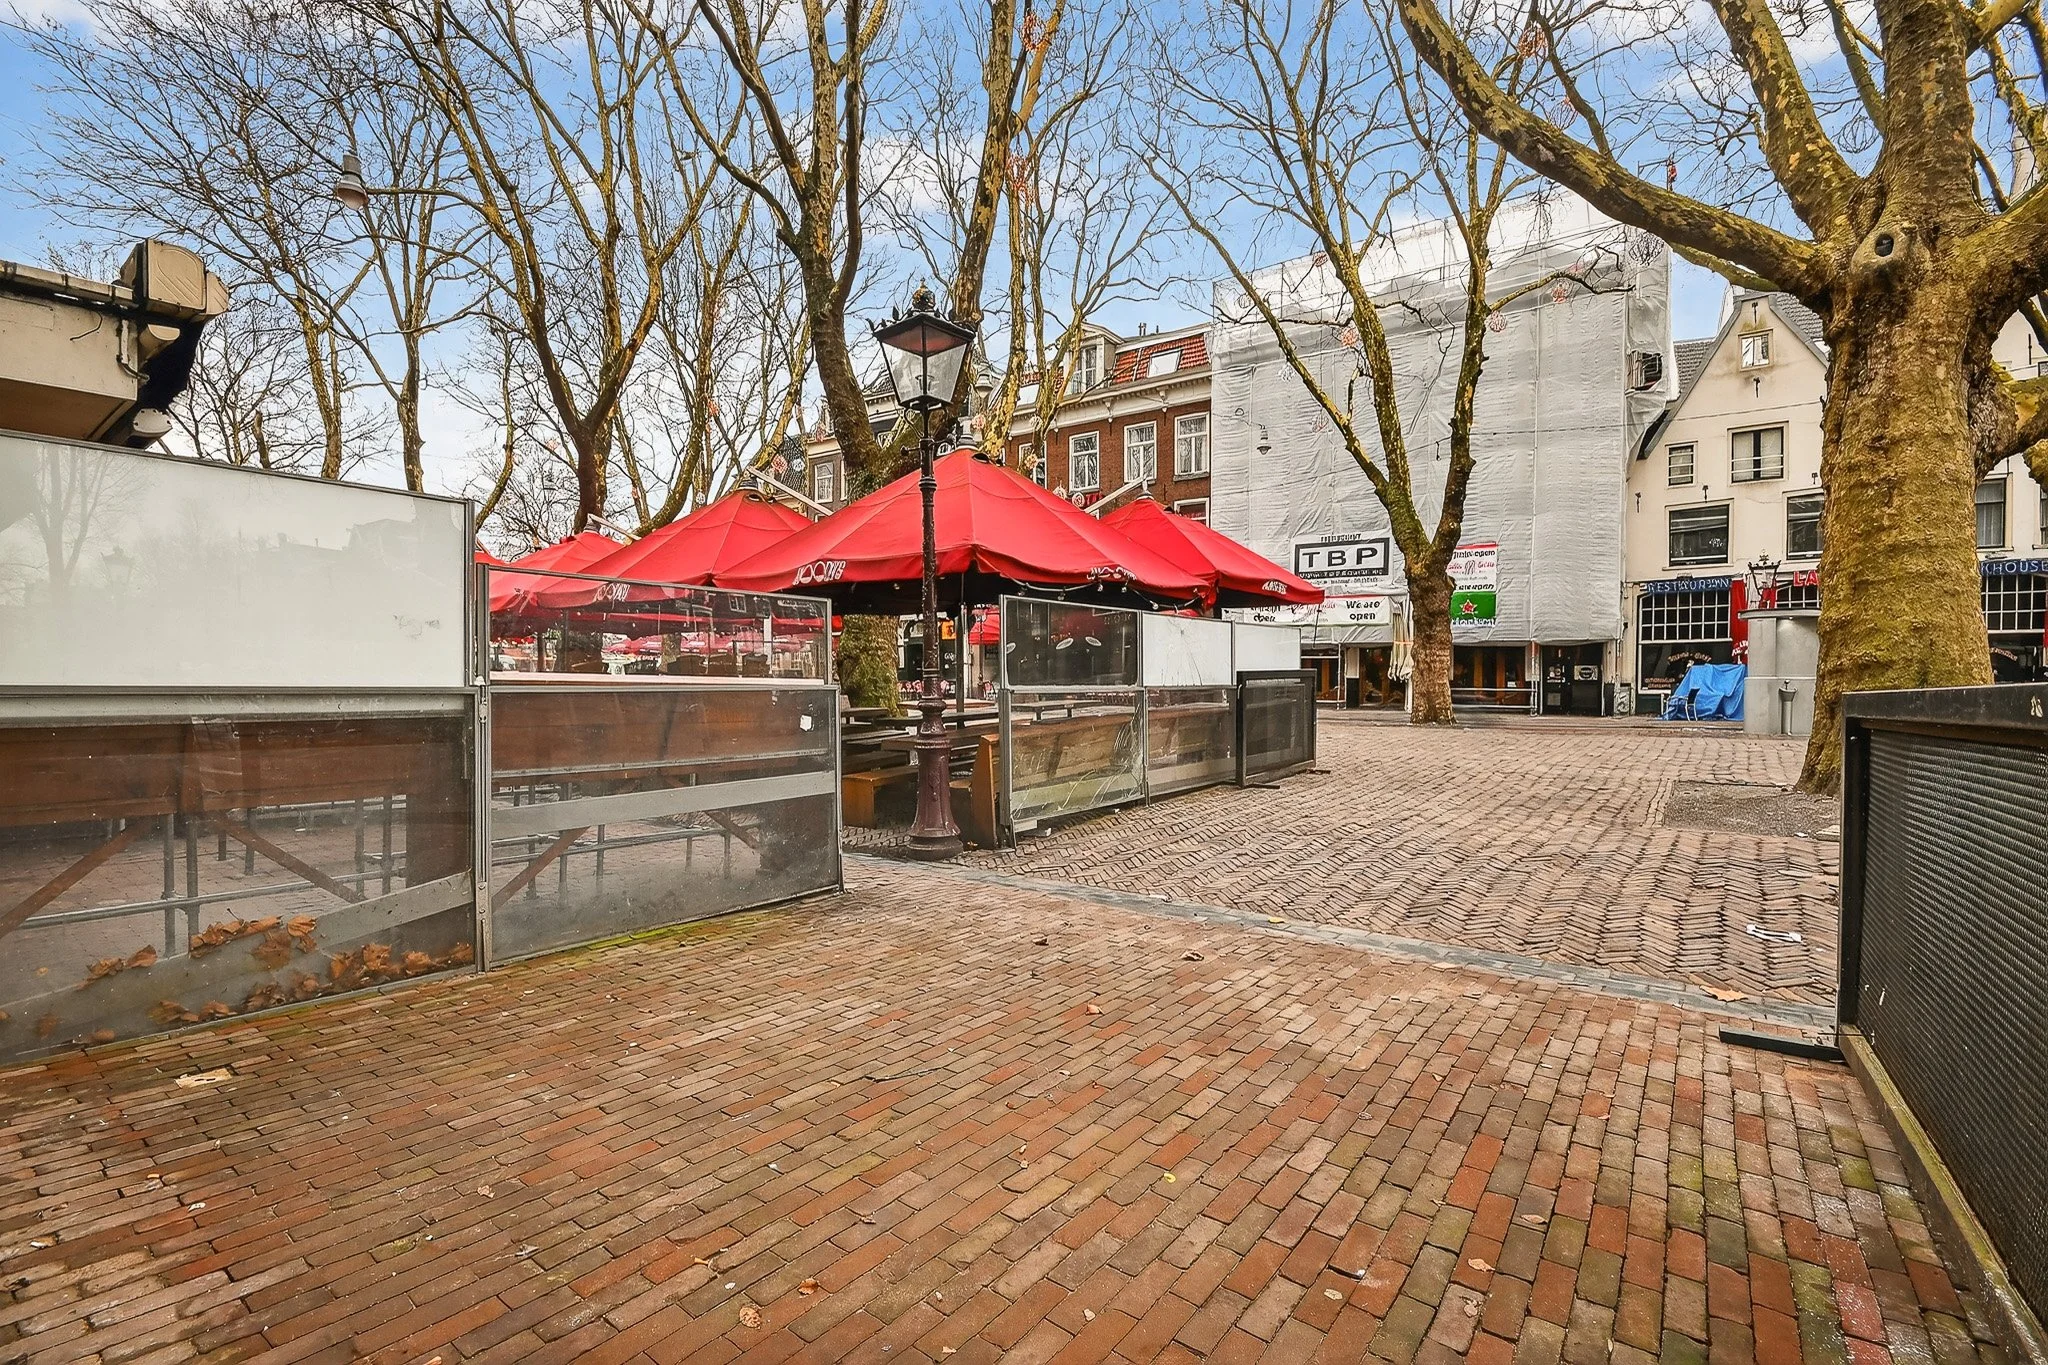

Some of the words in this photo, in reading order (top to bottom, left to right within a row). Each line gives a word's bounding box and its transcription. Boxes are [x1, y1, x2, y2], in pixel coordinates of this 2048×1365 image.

[1302, 547, 1378, 567] TBP
[1345, 601, 1361, 609] We
[1349, 612, 1376, 622] open
